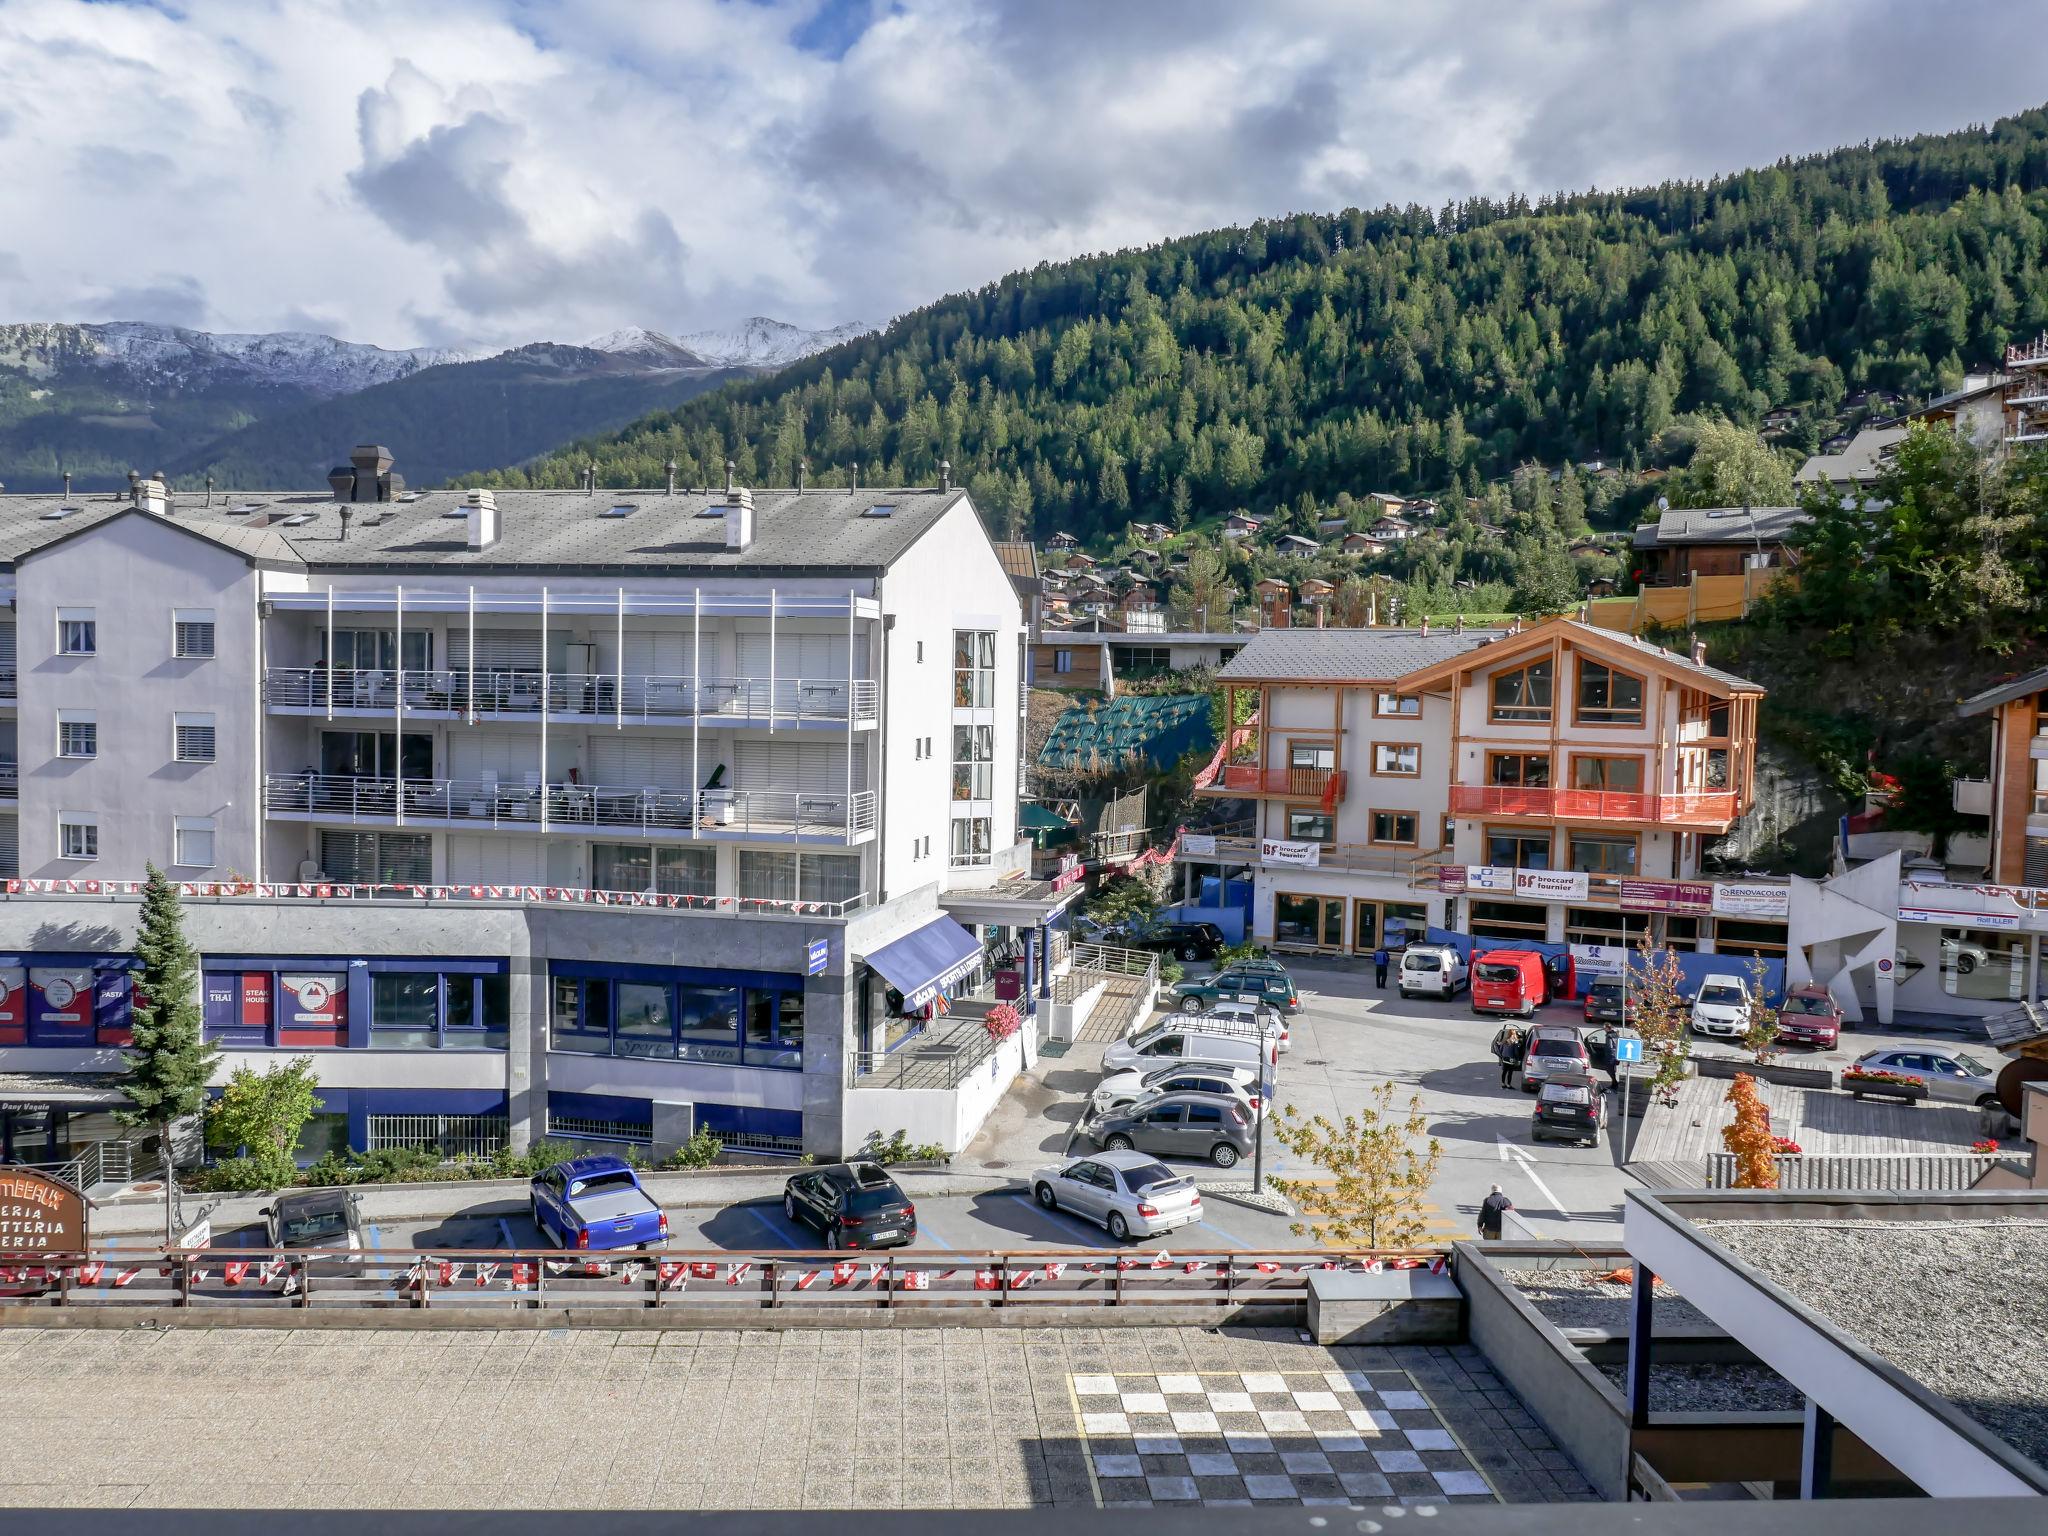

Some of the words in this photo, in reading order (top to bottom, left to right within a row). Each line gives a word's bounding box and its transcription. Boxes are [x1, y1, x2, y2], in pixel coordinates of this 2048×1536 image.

[1280, 845, 1309, 853] broccard
[1537, 875, 1575, 884] broccard
[1537, 882, 1572, 891] fournier
[1679, 886, 1710, 896] VENTE
[1730, 889, 1788, 898] RENOVACOLOR
[1991, 917, 2014, 925] ILLER
[209, 993, 232, 1002] THAI
[245, 989, 269, 997] STEAK
[2, 1102, 22, 1111] Dany
[23, 1102, 50, 1111] Vaquin
[1, 1205, 41, 1219] ERIA
[0, 1221, 64, 1234] TTERIA
[1, 1236, 48, 1248] ERIA
